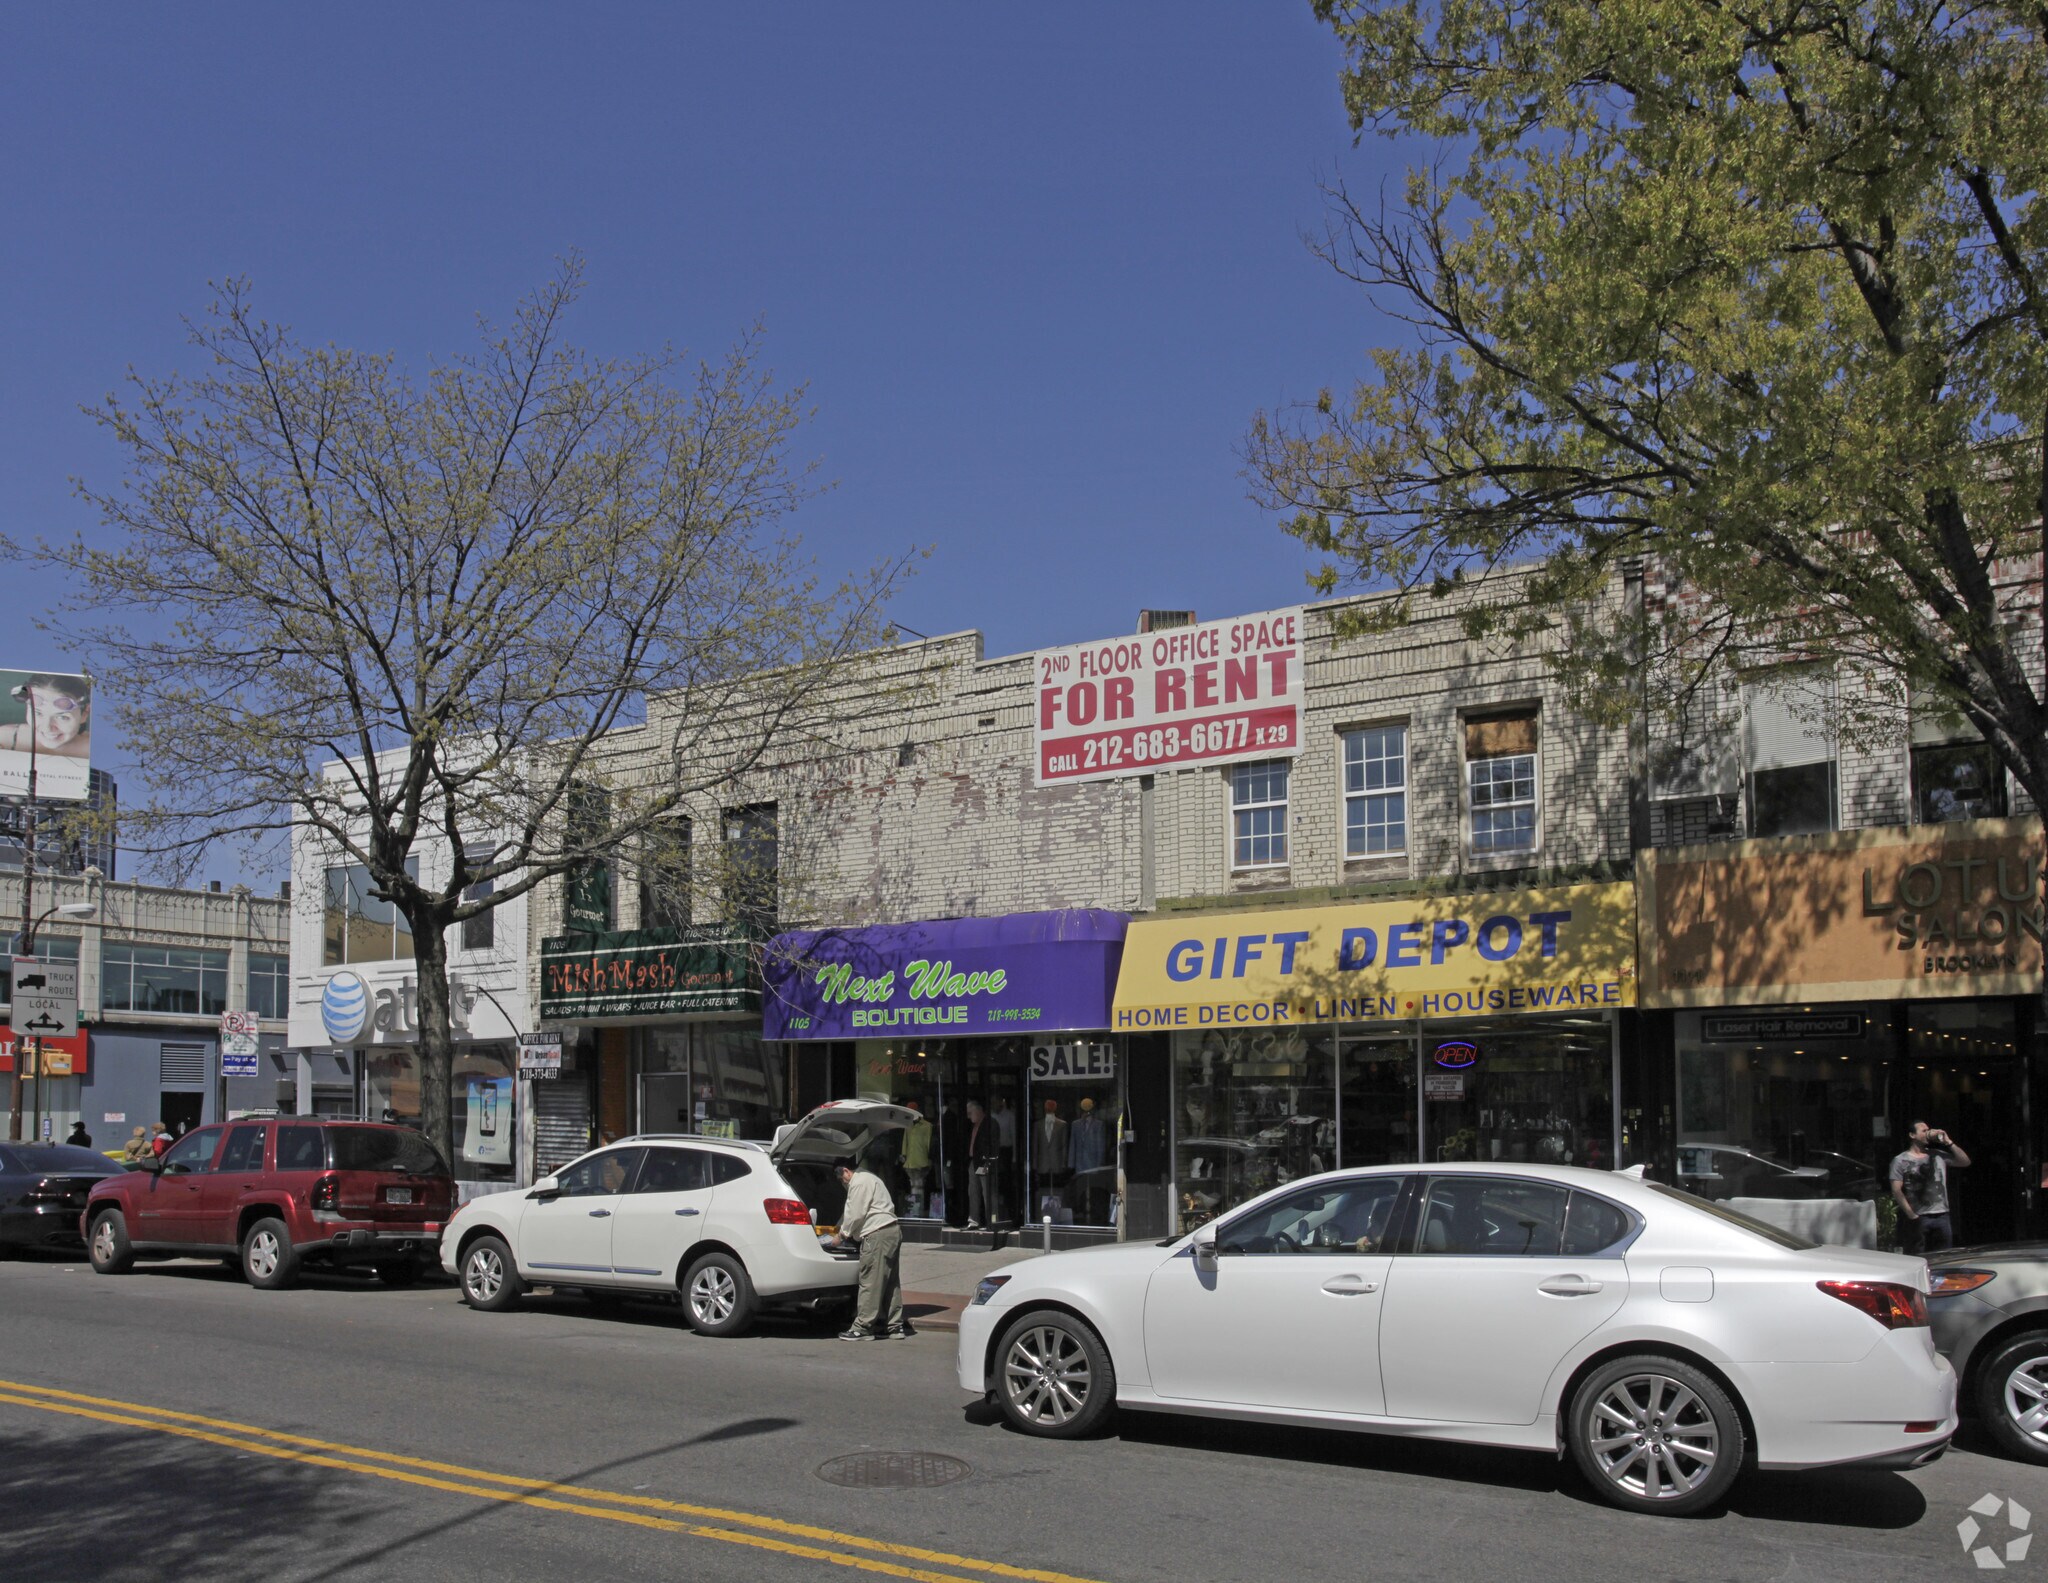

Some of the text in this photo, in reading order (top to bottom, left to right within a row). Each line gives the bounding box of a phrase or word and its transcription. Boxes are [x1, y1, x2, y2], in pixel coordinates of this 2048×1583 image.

[1041, 616, 1296, 685] 2ND FLOOR OFFICE SPACE
[1040, 649, 1297, 731] FOR RENT
[1048, 717, 1288, 773] CALL 212-683-6677 X 29
[1862, 857, 2037, 911] LOTU
[569, 903, 605, 922] Gourmet
[1896, 904, 2044, 950] SALON
[1166, 910, 1572, 982] GIFT DEPOT
[49, 972, 74, 981] TRUCK
[549, 951, 734, 993] Mish Mash Gourmet
[1924, 953, 2017, 974] BROOKLYN
[48, 986, 74, 995] ROUTE
[815, 959, 1007, 1004] Next Wave
[29, 1000, 61, 1010] LOCAL
[544, 1006, 572, 1015] SALADS
[605, 1002, 632, 1012] WRAPS
[637, 1001, 658, 1010] JUICE
[659, 1000, 676, 1009] BAR
[681, 998, 700, 1008] FULL
[701, 997, 739, 1007] CATERING
[789, 1017, 811, 1030] 1105
[852, 1006, 968, 1027] BOUTIQUE
[1118, 982, 1621, 1027] HOME DECOR LINEN HOUSEWARE
[523, 1034, 540, 1044] OFFICE
[550, 1033, 560, 1043] RENT
[1717, 1018, 1848, 1033] Laser Hair Removal
[1033, 1045, 1111, 1077] SALE!
[1434, 1047, 1477, 1063] OPEN
